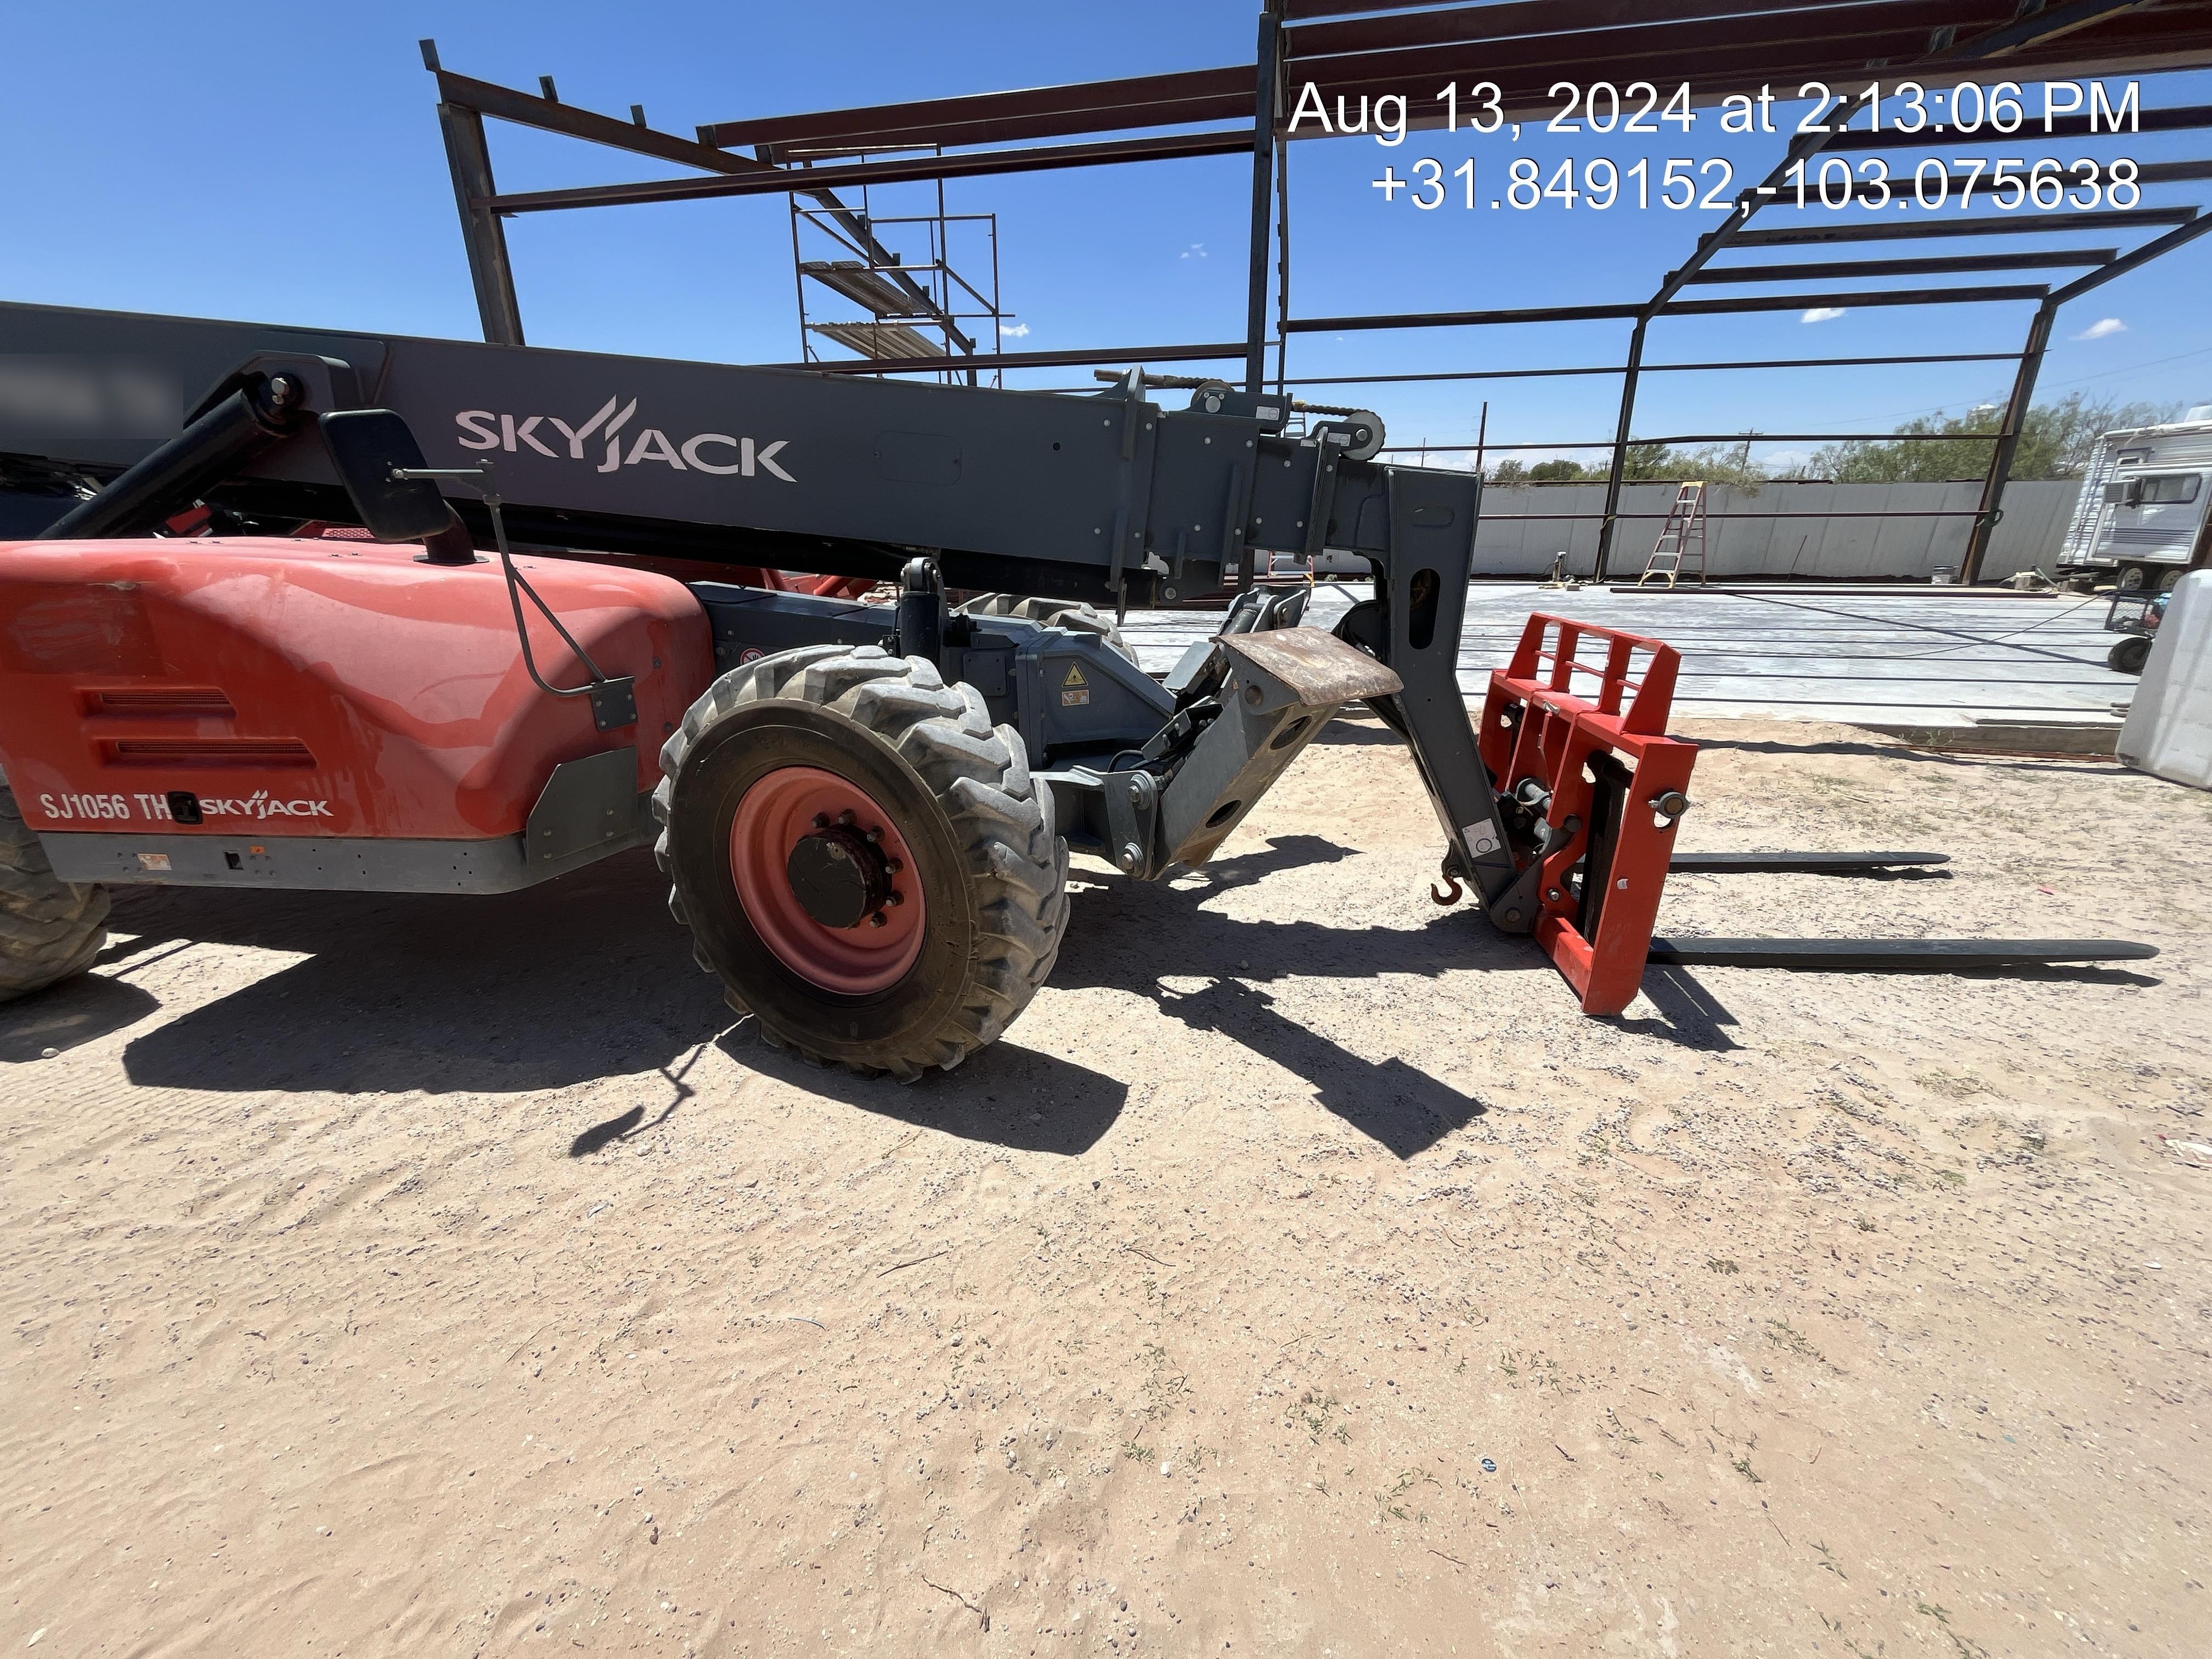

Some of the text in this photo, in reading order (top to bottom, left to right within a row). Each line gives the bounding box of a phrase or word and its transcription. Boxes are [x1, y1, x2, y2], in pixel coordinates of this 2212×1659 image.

[455, 394, 798, 483] SKYJACK
[40, 793, 173, 820] SJ1056 TH
[199, 789, 335, 820] SKYJACK
